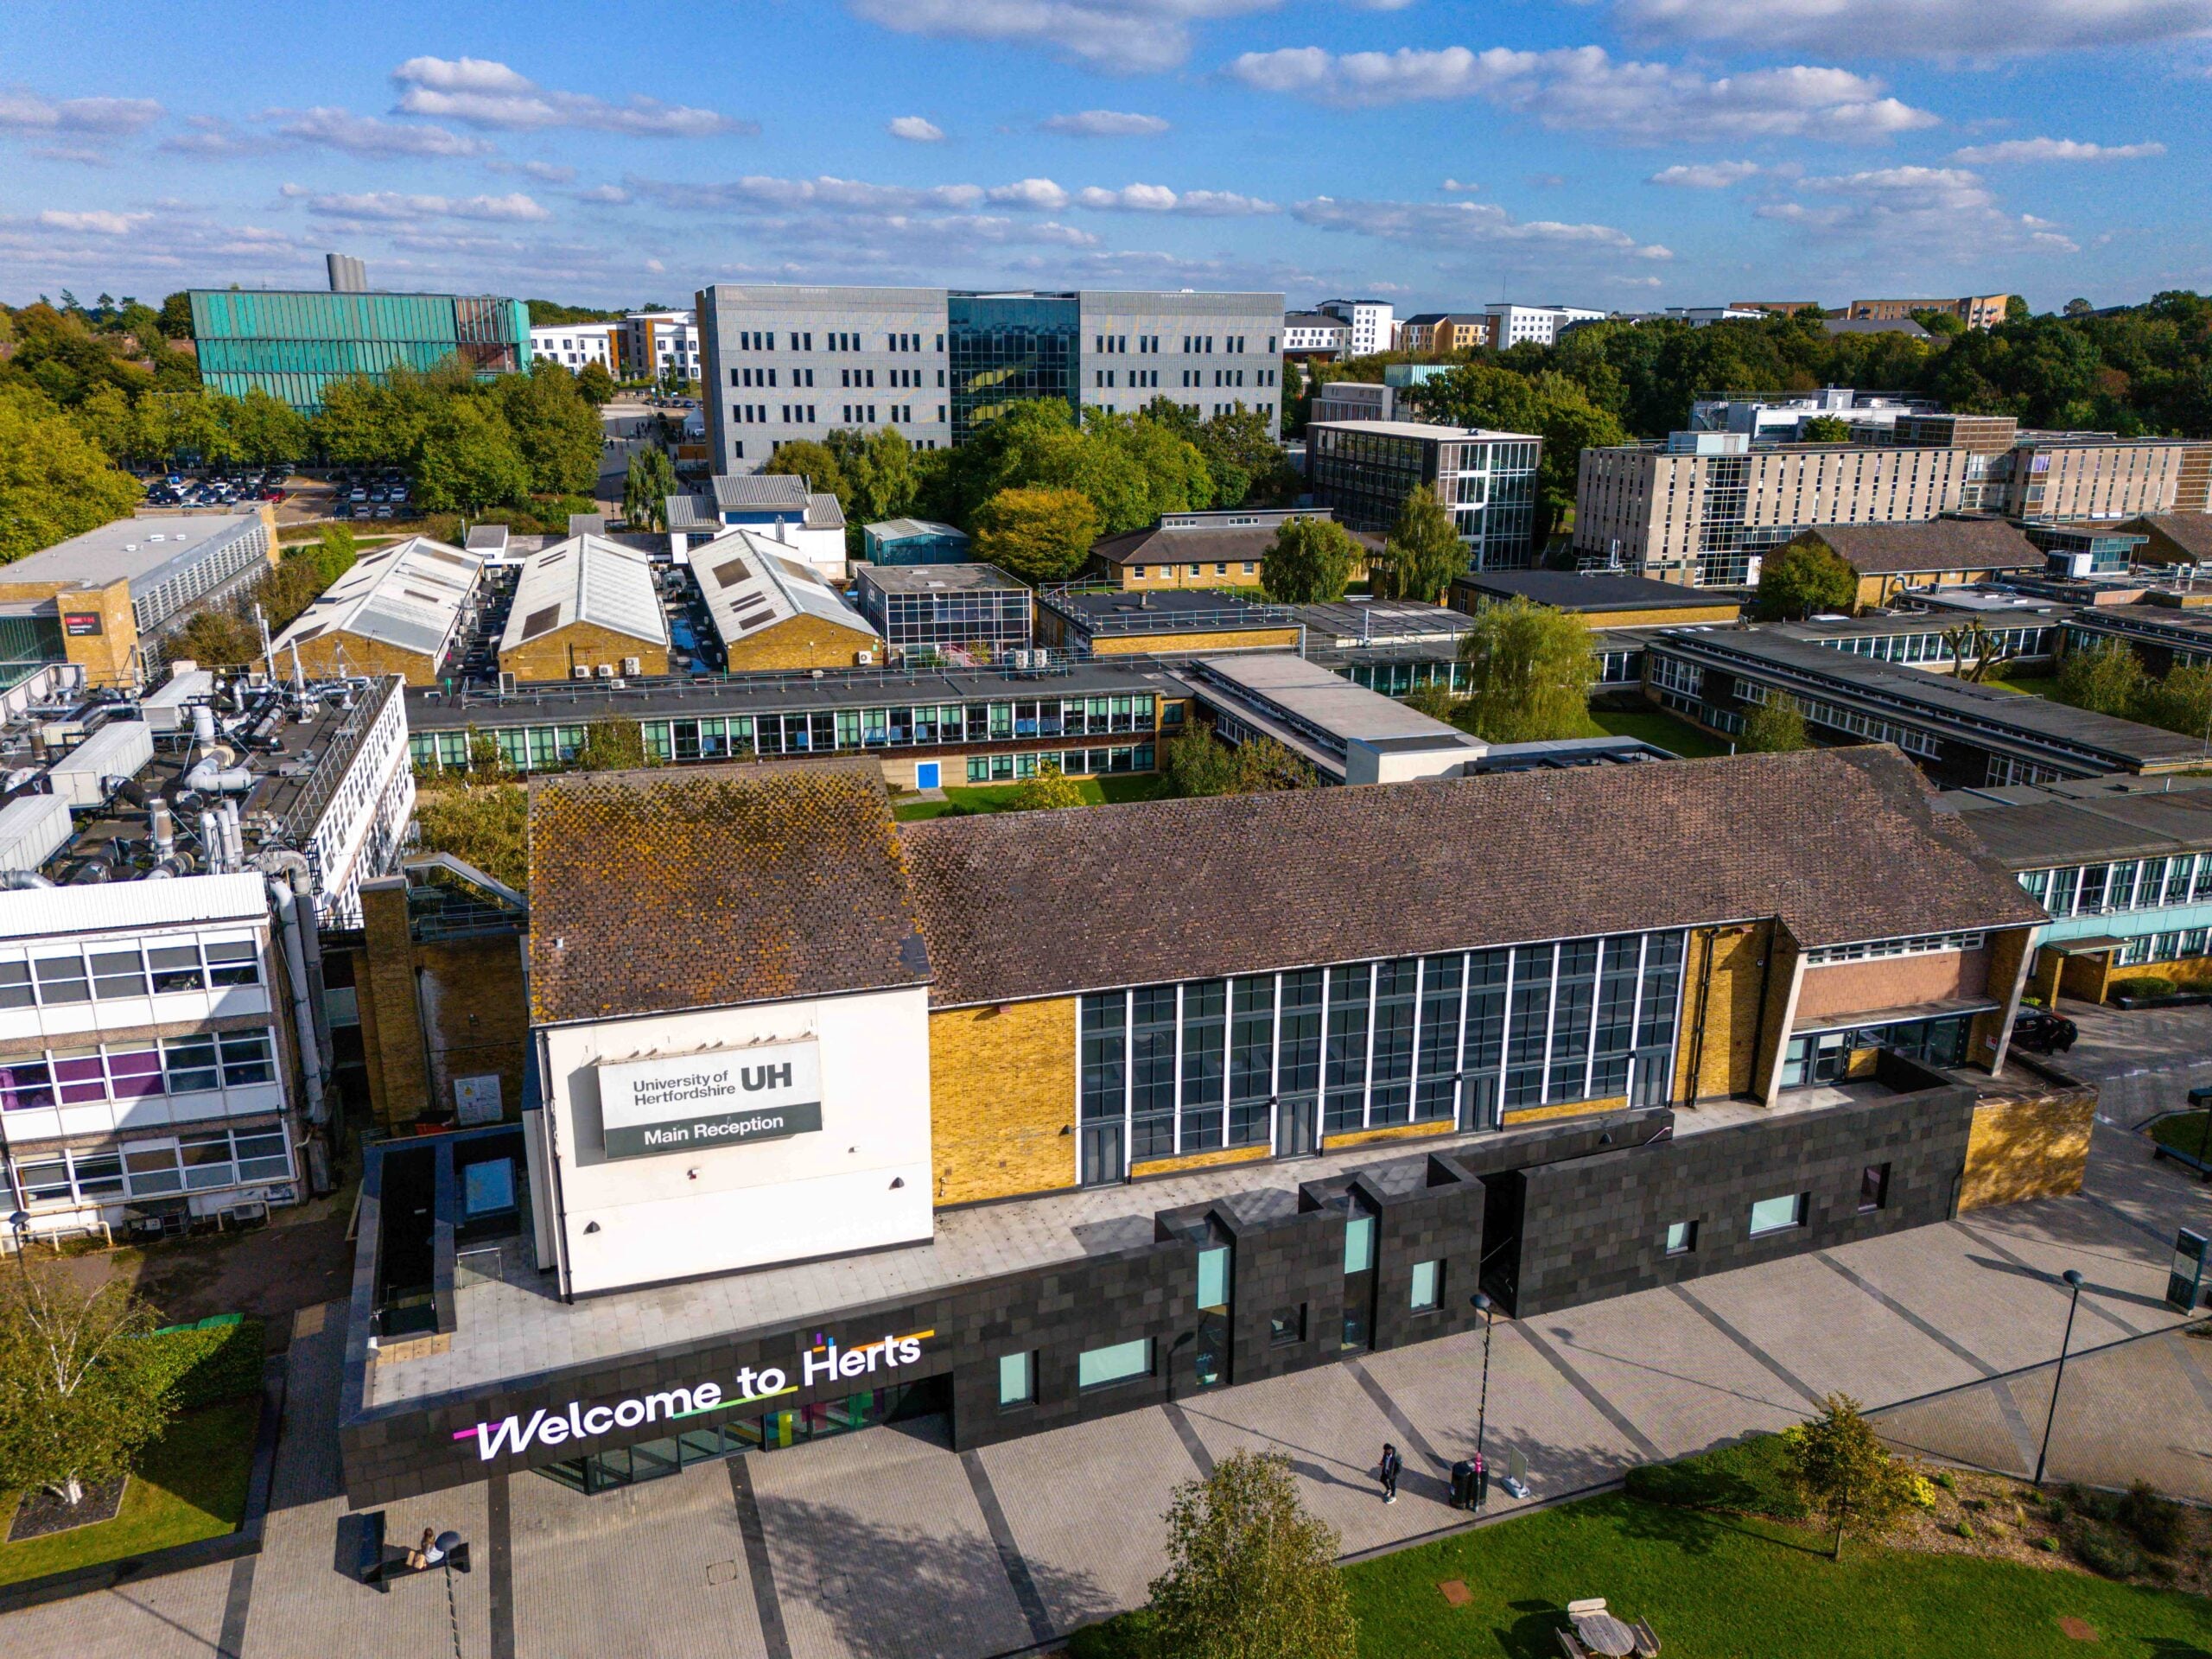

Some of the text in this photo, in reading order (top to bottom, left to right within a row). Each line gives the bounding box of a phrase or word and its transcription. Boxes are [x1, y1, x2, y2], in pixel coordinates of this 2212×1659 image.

[633, 1070, 729, 1092] University of
[741, 1062, 792, 1091] UH
[634, 1084, 735, 1106] Hertfordshire
[644, 1116, 784, 1146] Main Reception
[477, 1335, 921, 1461] Welcome to Herts
